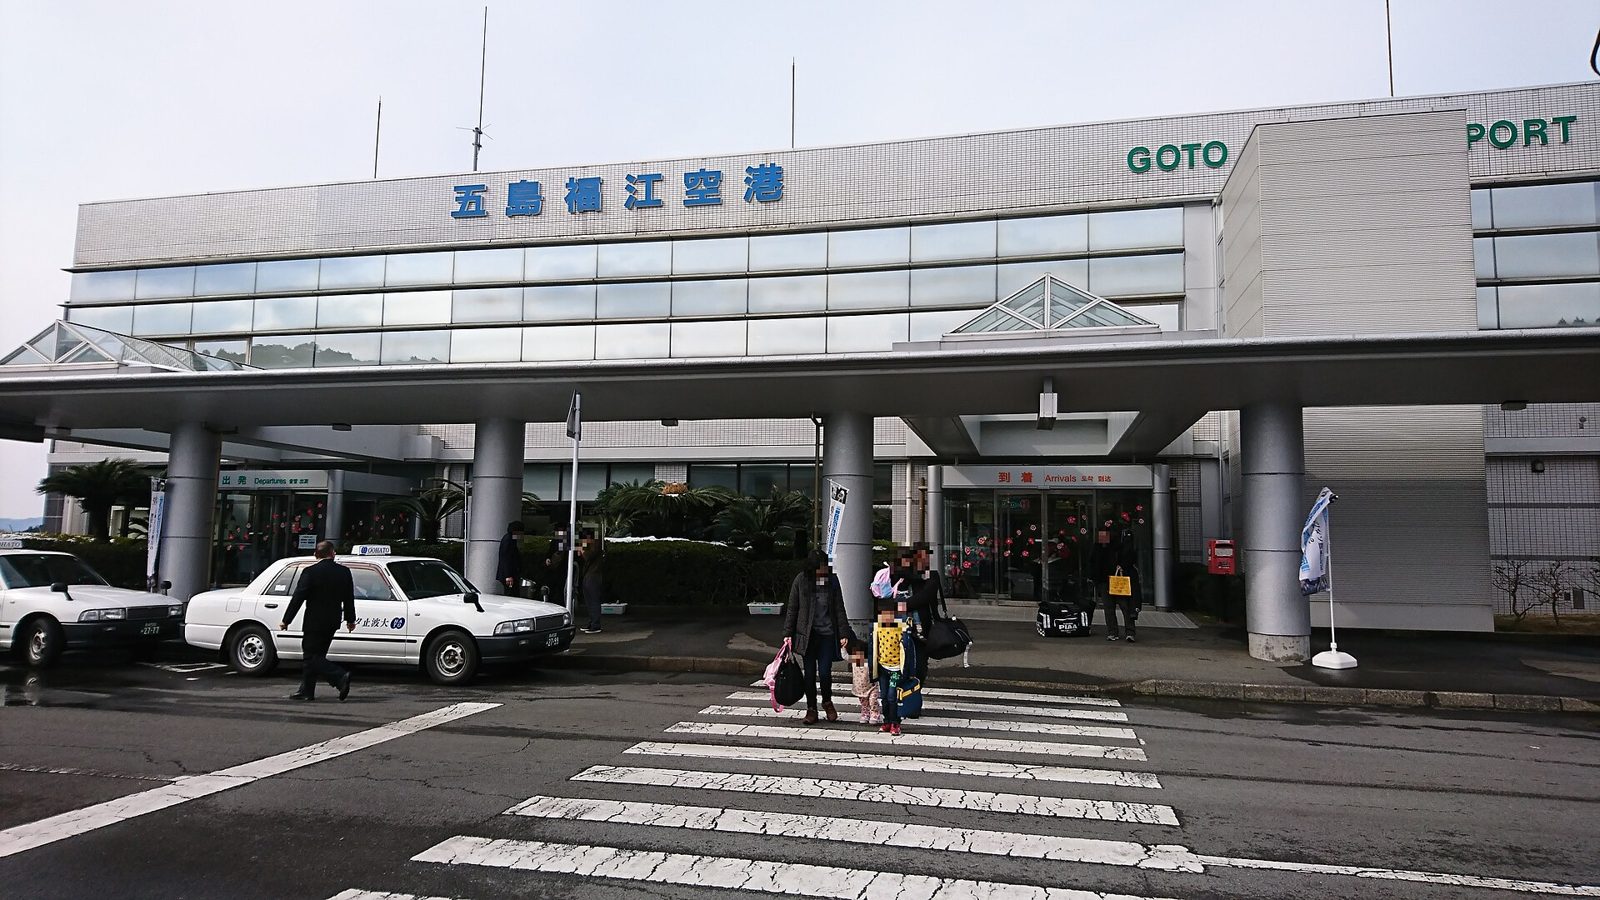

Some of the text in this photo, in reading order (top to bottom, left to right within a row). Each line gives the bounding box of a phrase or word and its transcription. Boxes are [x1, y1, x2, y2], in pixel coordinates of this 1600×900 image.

[1127, 115, 1577, 174] GOTO PORT
[450, 162, 784, 219] 五島福江空港
[222, 475, 247, 485] 出発
[254, 477, 287, 486] Departures
[998, 471, 1033, 483] 到着
[1044, 474, 1077, 483] Arrivals
